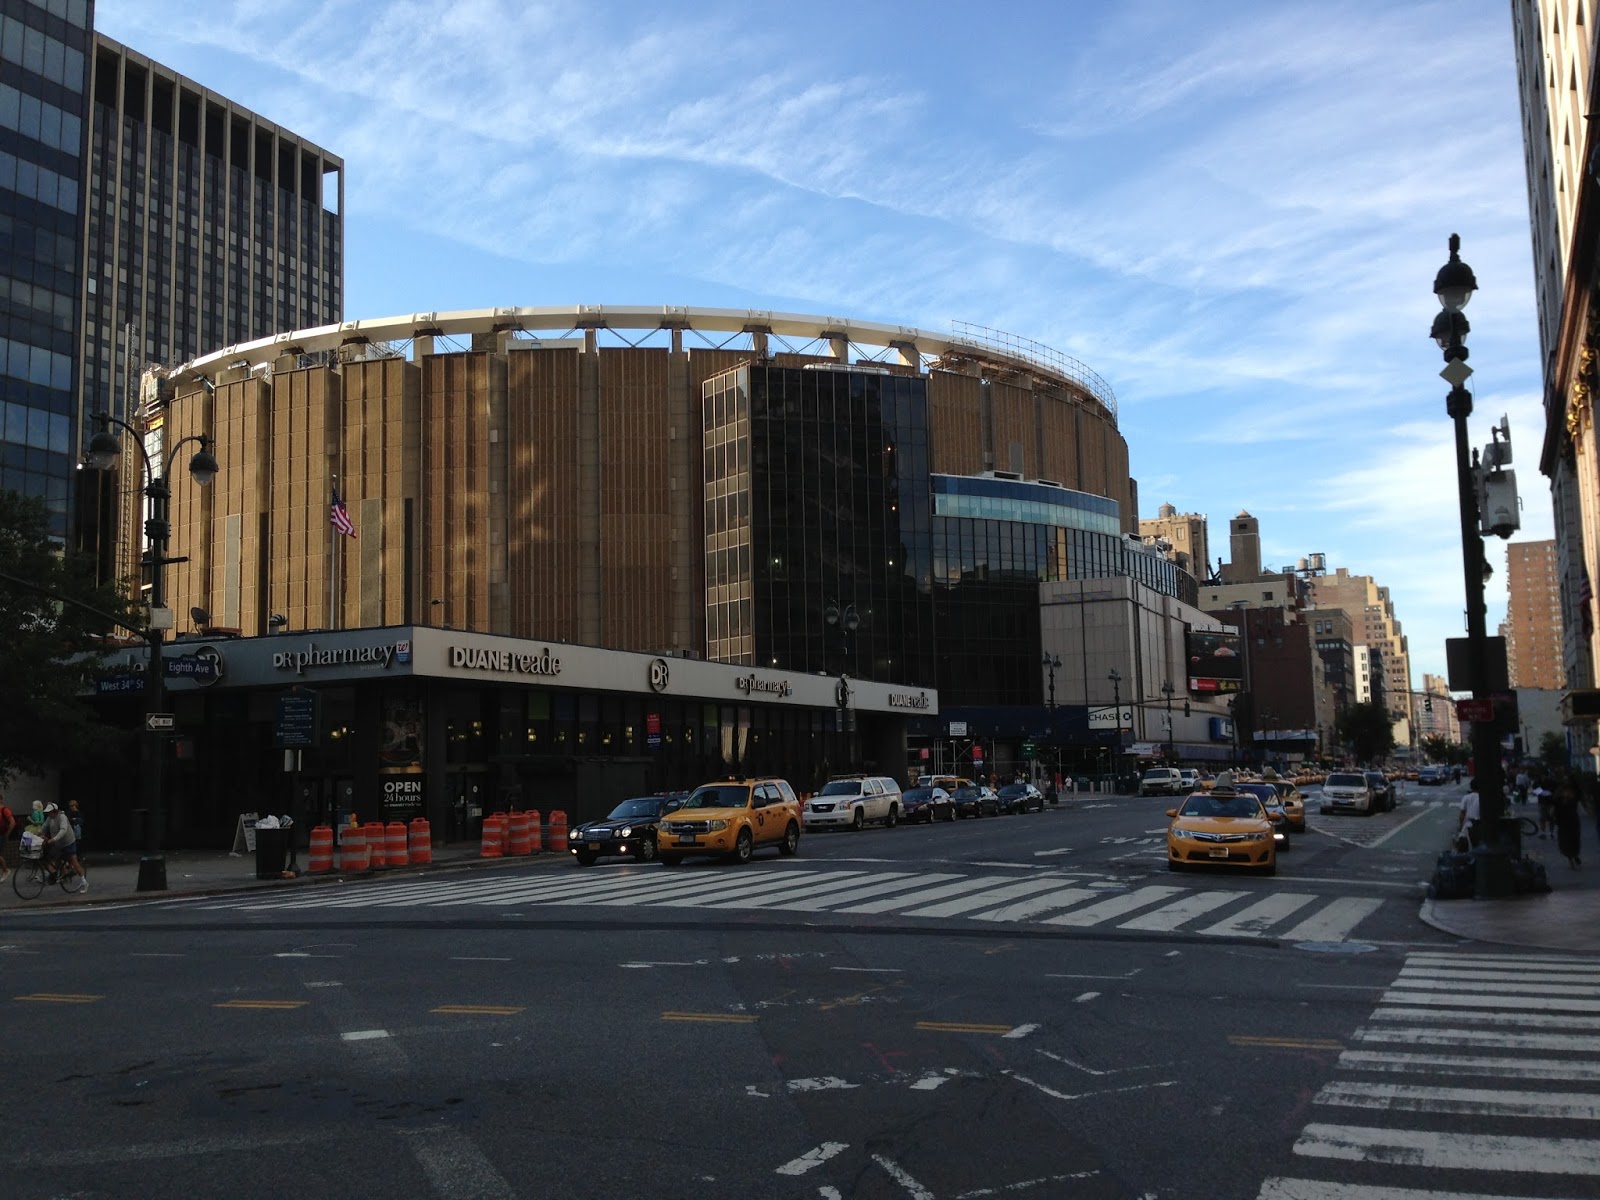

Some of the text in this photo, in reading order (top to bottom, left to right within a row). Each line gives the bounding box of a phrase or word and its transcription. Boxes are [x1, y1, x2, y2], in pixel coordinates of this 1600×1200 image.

[272, 643, 396, 674] DR pharmacy
[451, 646, 562, 676] DUANE reade
[168, 661, 210, 674] Eighth Ave
[651, 664, 669, 685] DR
[100, 679, 145, 691] West 34th St
[748, 673, 787, 697] pharmacy
[890, 693, 911, 707] DUANE
[383, 781, 422, 793] OPEN
[383, 792, 421, 803] 24 hours
